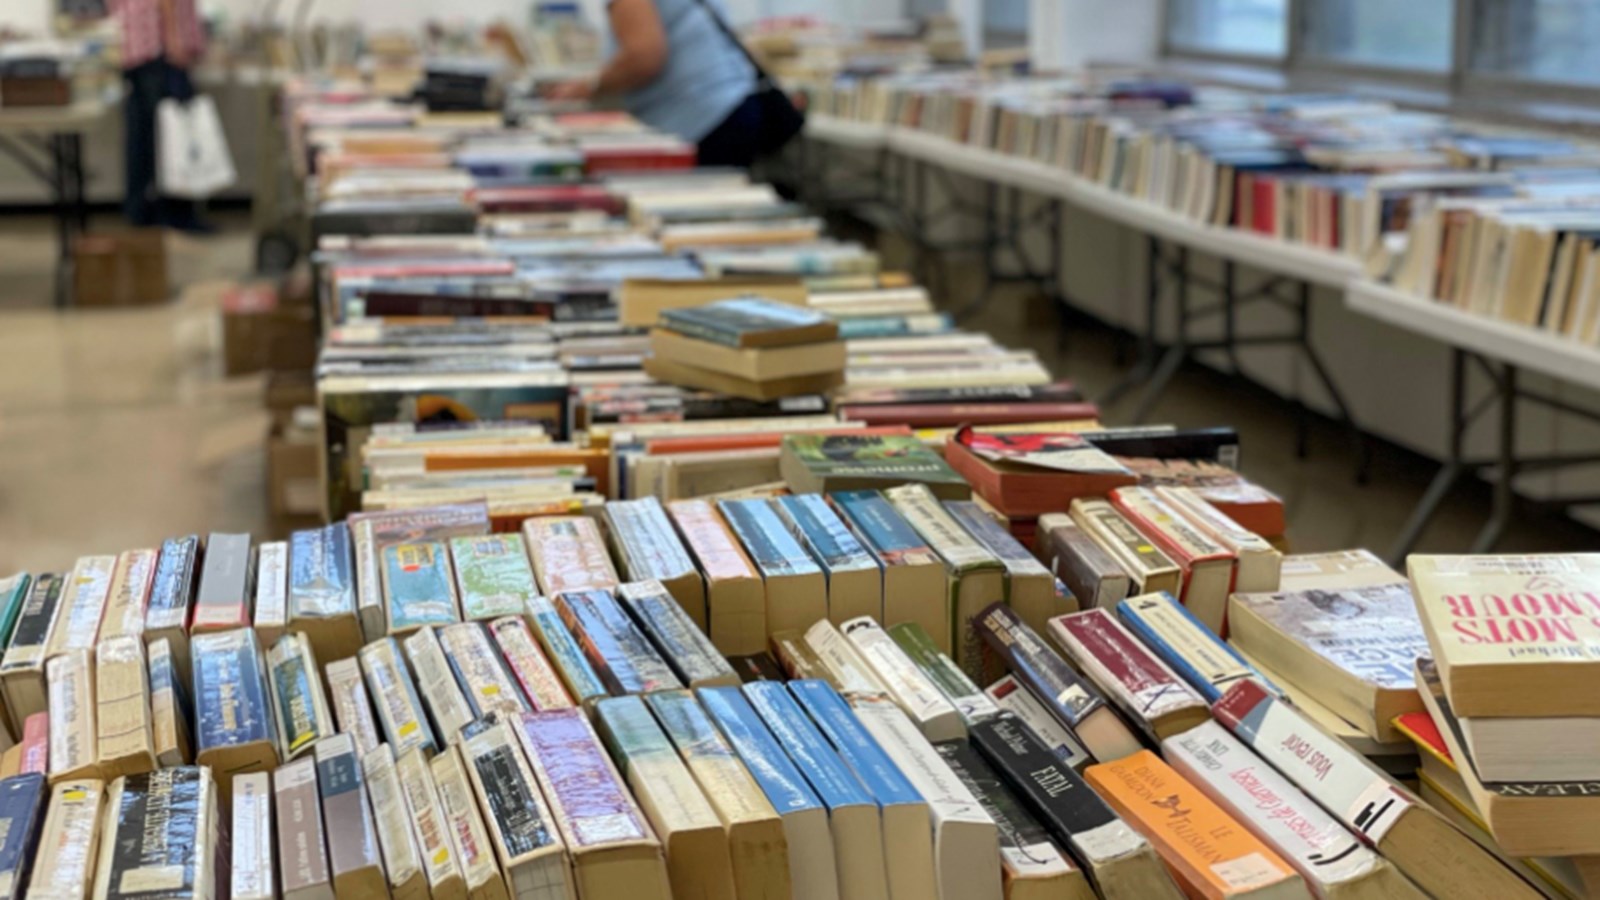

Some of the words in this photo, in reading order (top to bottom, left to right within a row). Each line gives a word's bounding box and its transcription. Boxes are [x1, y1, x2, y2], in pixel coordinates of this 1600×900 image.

[1451, 617, 1578, 644] MOTS
[1508, 646, 1584, 658] Michael
[1206, 738, 1229, 757] LINK
[1281, 733, 1314, 760] revoir
[1133, 765, 1166, 790] DIANA
[1306, 750, 1334, 781] Vous
[1030, 765, 1073, 798] FATAL
[1166, 817, 1222, 864] TALISMAN
[1209, 825, 1234, 839] LE
